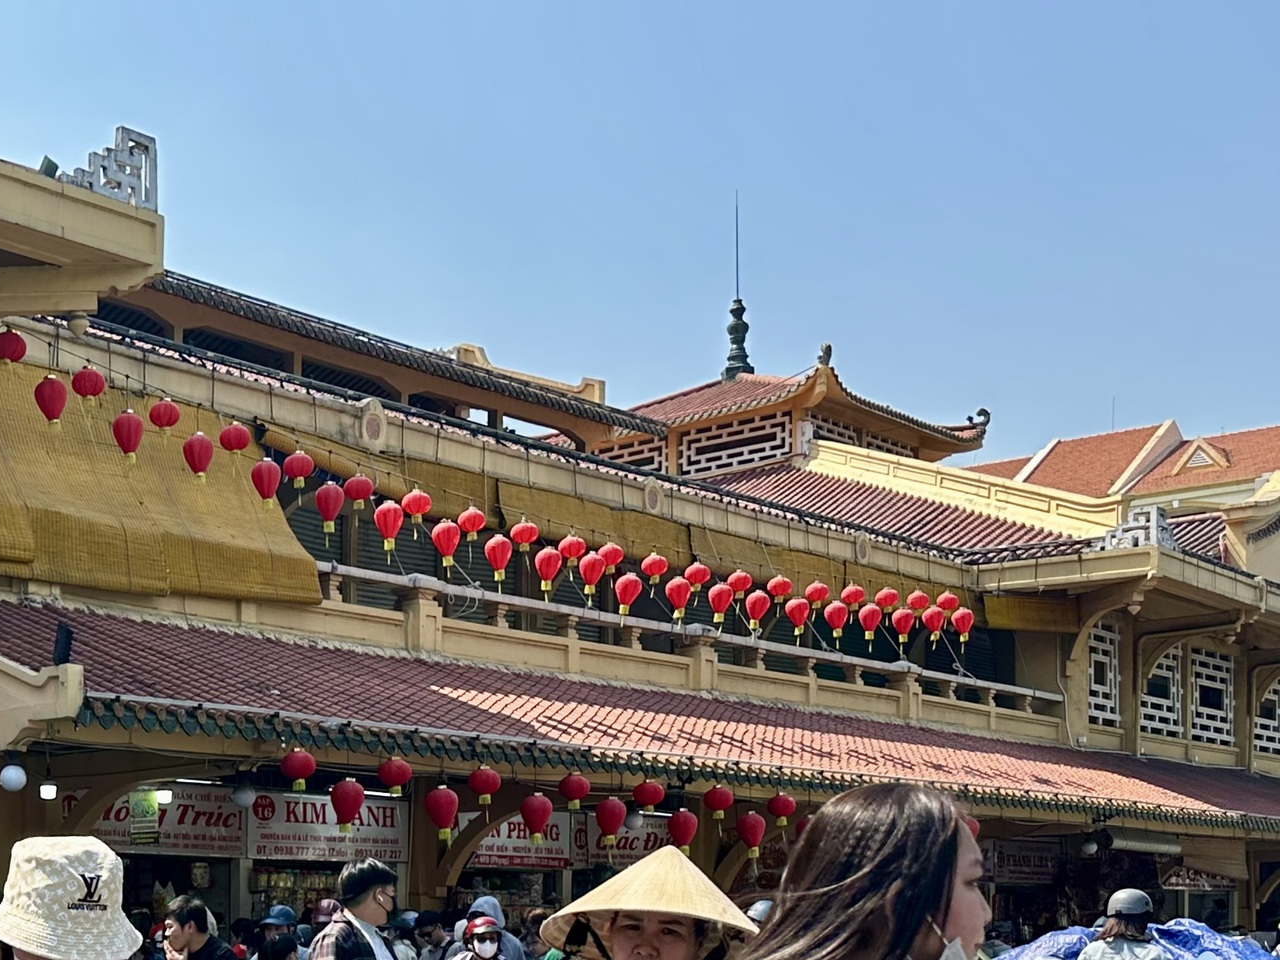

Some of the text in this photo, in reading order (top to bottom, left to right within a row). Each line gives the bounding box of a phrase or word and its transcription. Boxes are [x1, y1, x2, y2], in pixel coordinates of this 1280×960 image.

[176, 803, 237, 829] Trúc
[257, 807, 272, 819] 16
[284, 801, 328, 825] KIM
